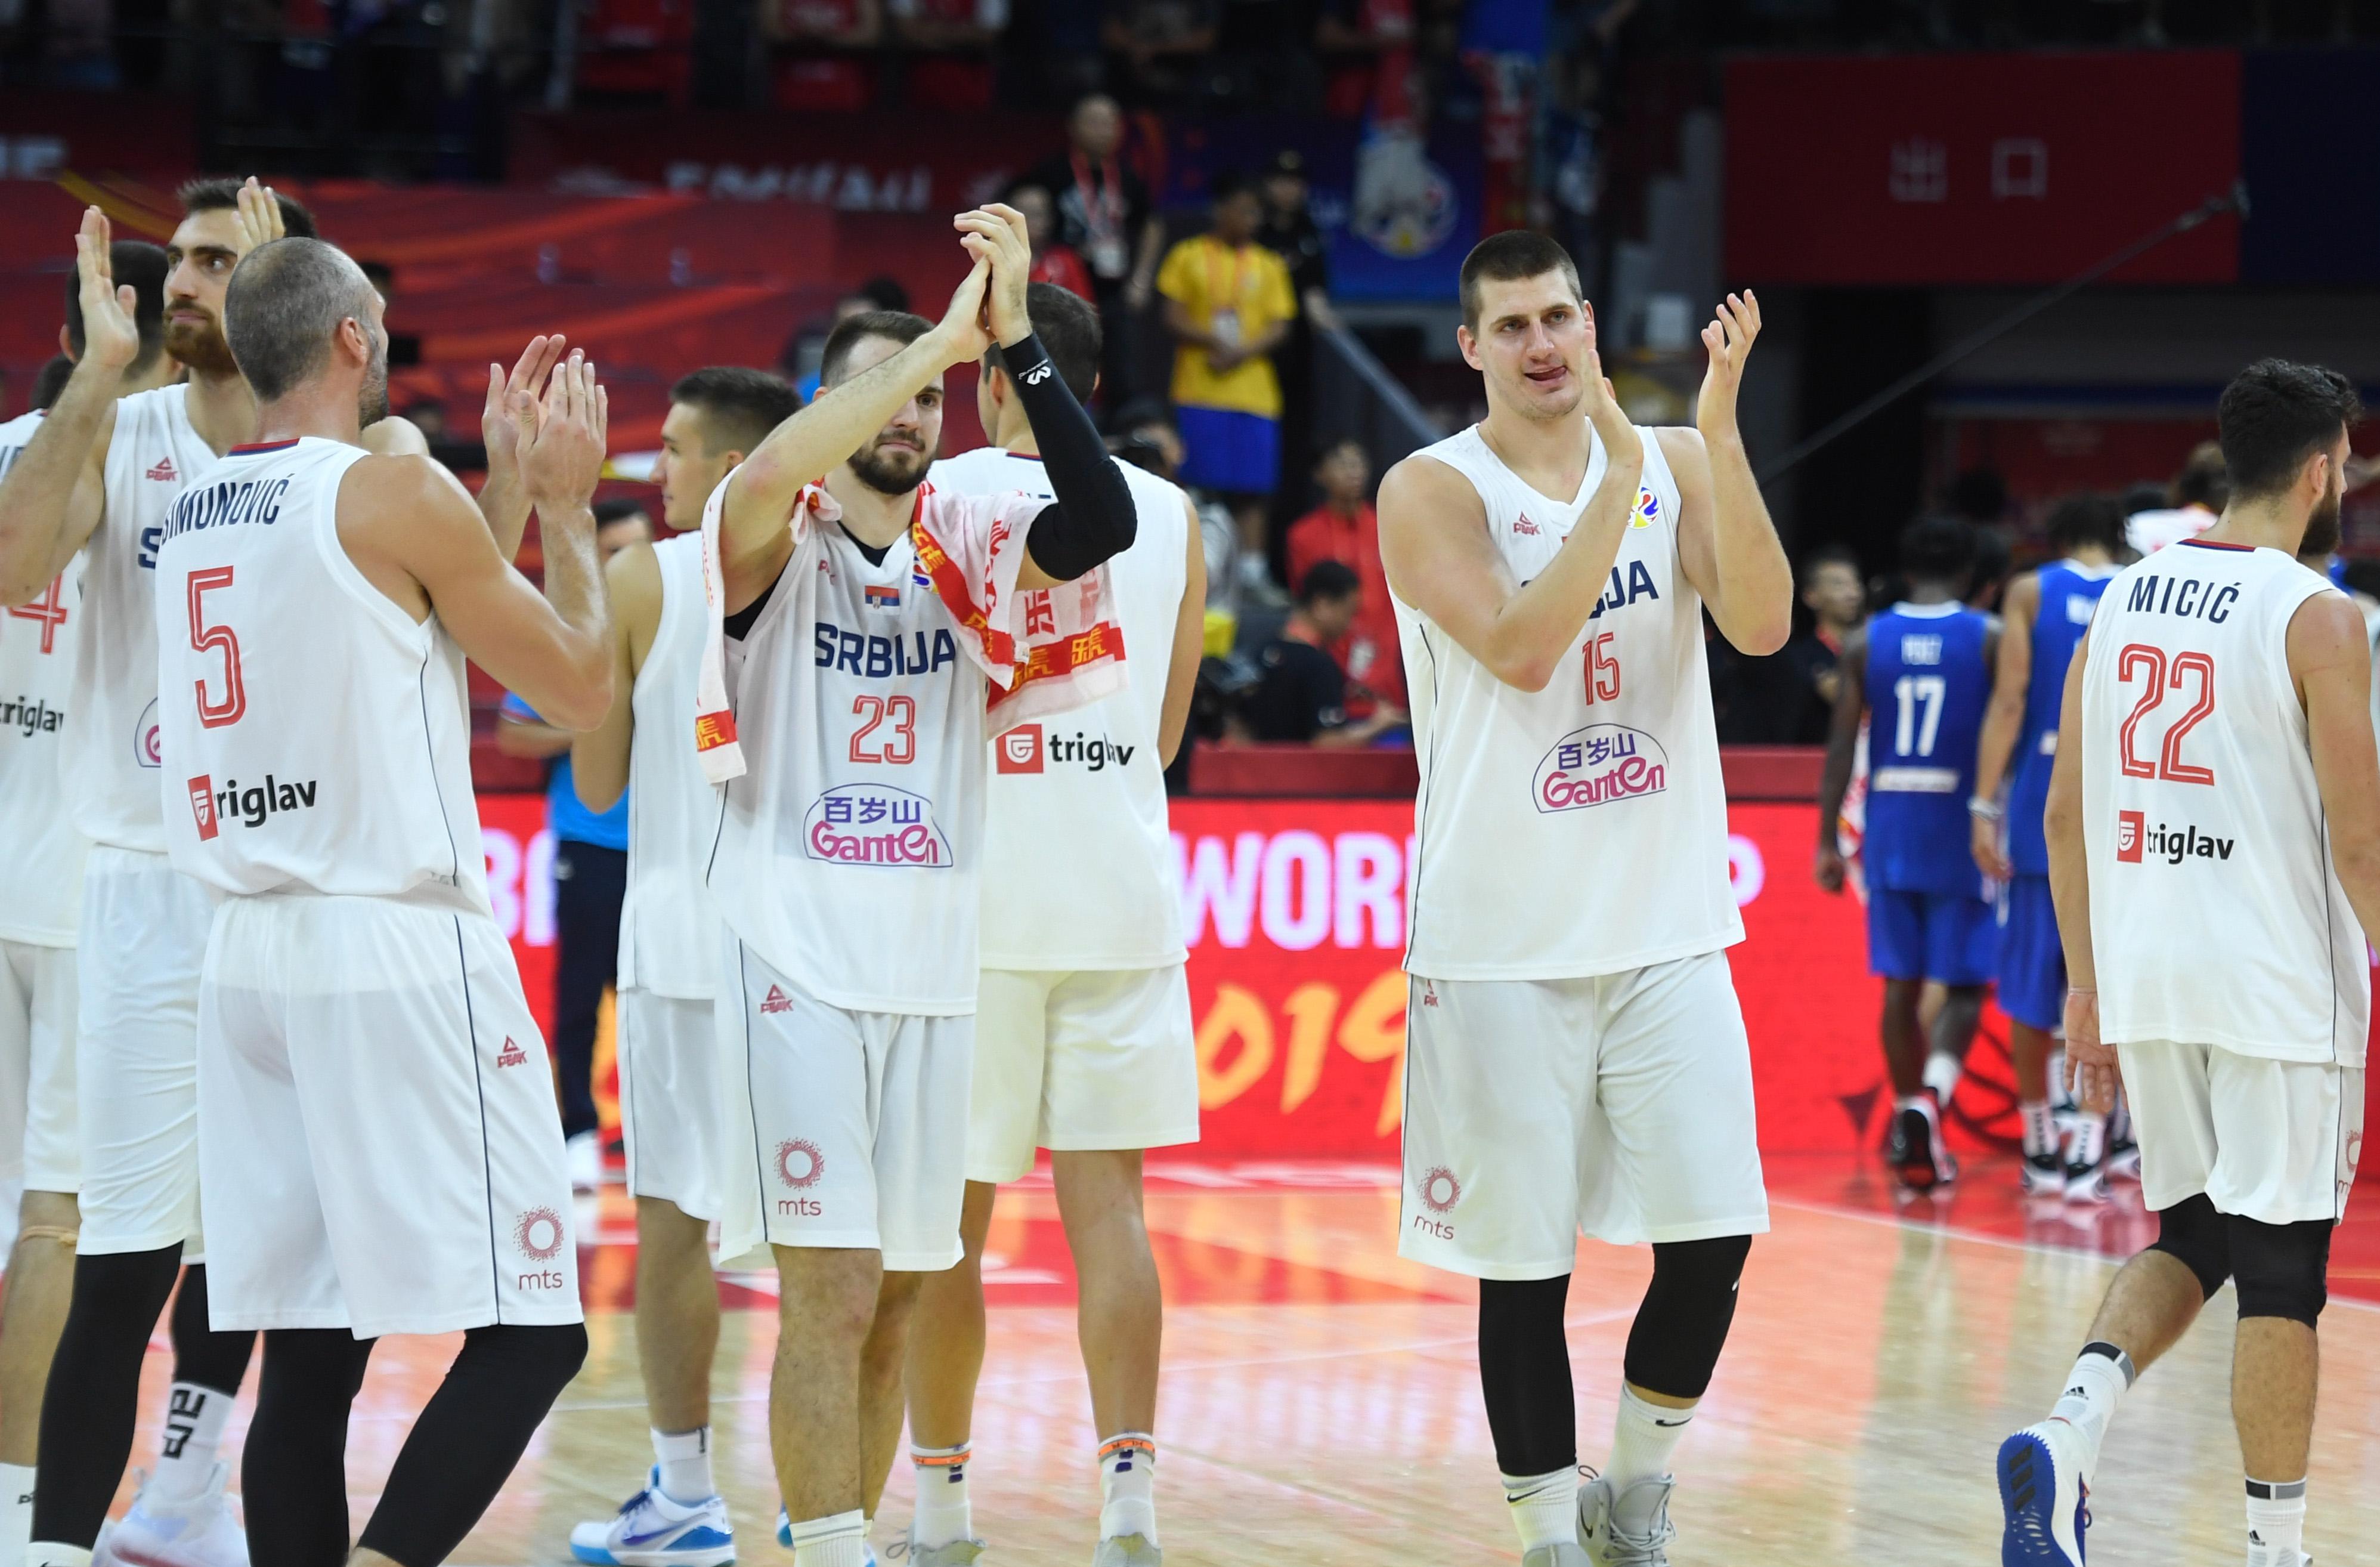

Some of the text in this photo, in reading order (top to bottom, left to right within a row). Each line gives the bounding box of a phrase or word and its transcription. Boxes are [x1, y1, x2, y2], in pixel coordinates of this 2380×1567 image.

[1889, 135, 2048, 202] 出口
[2127, 575, 2242, 624] MICIĆ
[187, 565, 245, 729] 5
[815, 622, 956, 678] SRBIJA
[1582, 632, 1620, 706] 15
[0, 696, 64, 737] rigla
[849, 695, 915, 764] 23
[1894, 675, 1946, 756] 17
[2118, 644, 2214, 786] 22
[1558, 733, 1636, 770] 百岁山
[214, 774, 317, 828] riglav
[824, 797, 921, 824] 百岁山
[2147, 823, 2234, 864] triglav
[1170, 829, 1415, 952] WOR
[1195, 968, 1406, 1139] 019
[778, 1197, 821, 1216] mts
[1414, 1215, 1454, 1240] mts
[519, 1269, 562, 1290] mts
